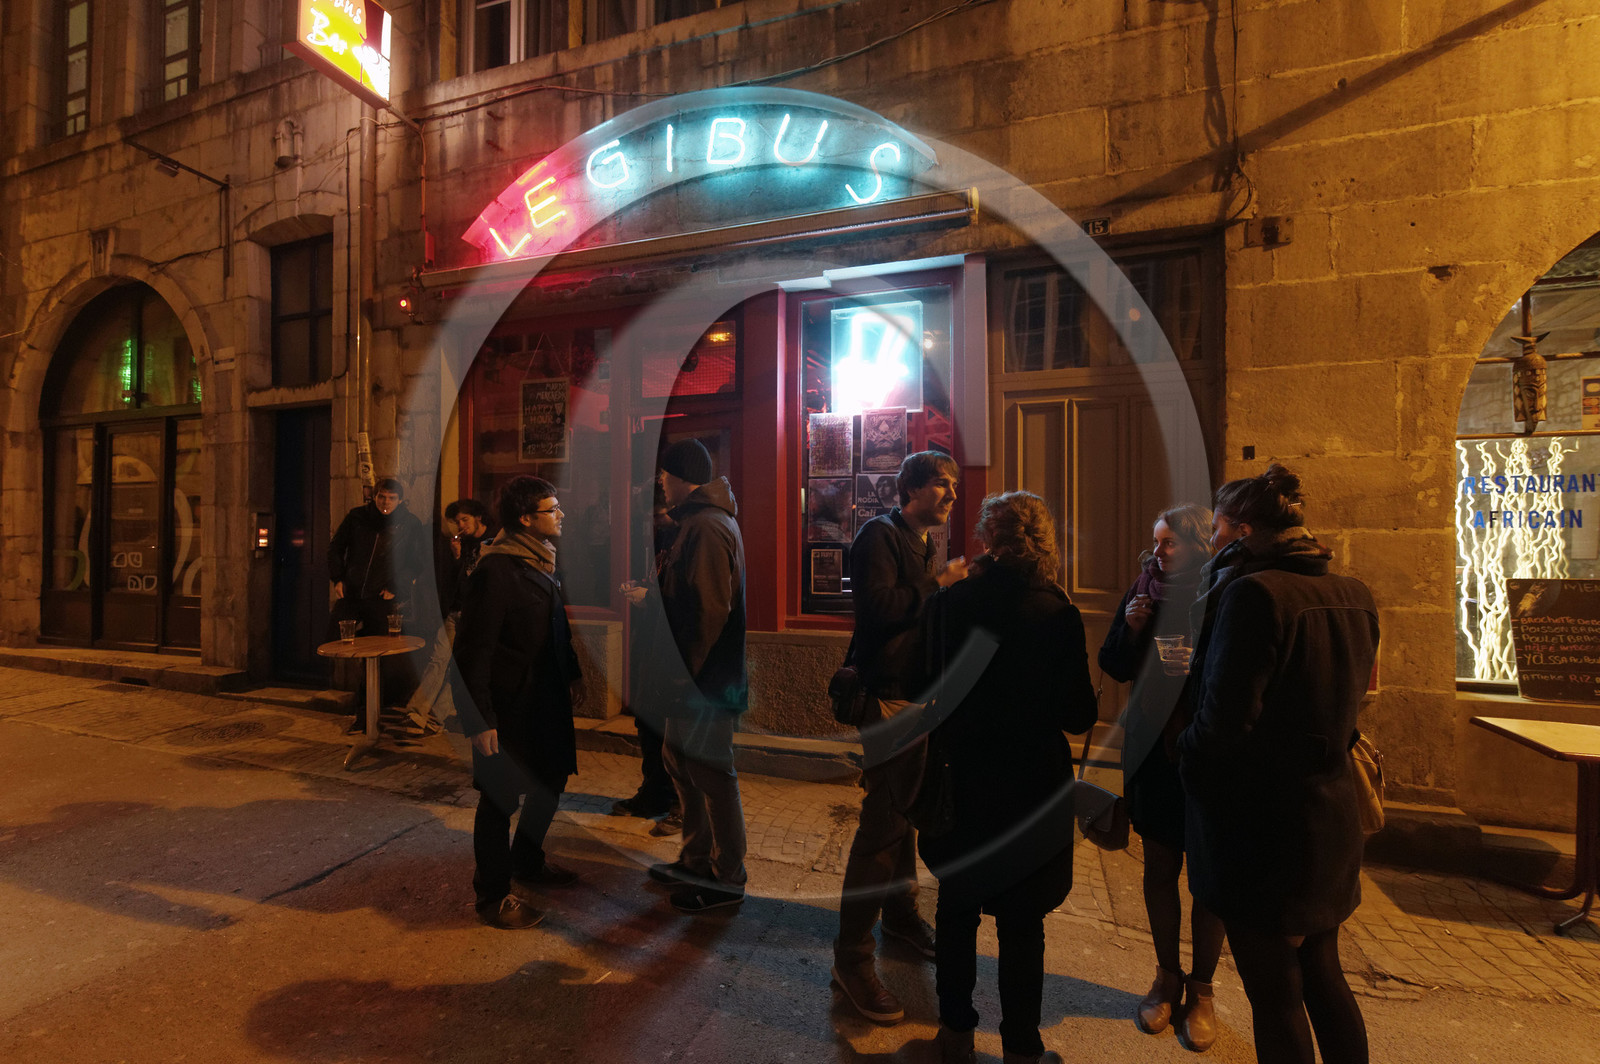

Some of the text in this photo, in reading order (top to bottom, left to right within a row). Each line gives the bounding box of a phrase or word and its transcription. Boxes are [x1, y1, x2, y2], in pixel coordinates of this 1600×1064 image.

[489, 113, 901, 257] LE GIBUS
[1089, 221, 1104, 235] 15
[1464, 473, 1600, 494] RESTAURAN
[1473, 509, 1583, 529] AFRICAIN
